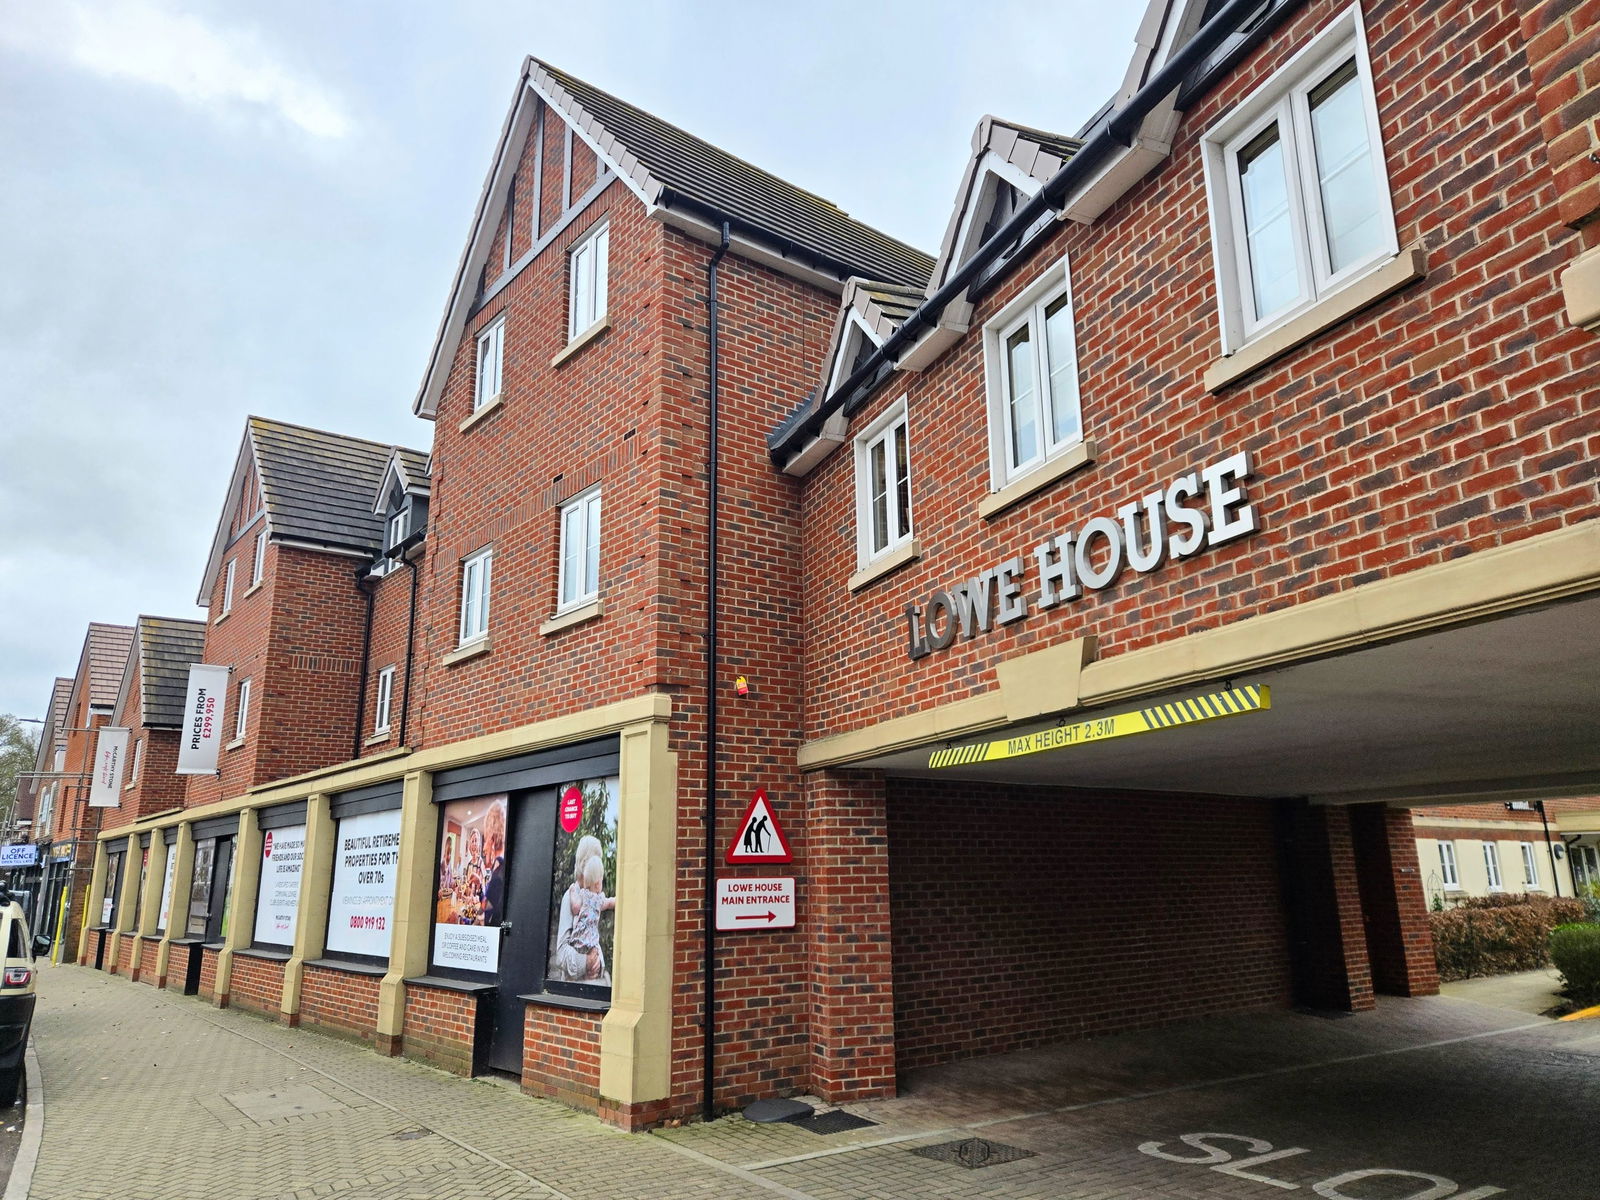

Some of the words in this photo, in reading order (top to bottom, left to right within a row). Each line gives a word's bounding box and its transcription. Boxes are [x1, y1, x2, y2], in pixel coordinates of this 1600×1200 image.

[905, 555, 1028, 661] LOWE
[1033, 450, 1261, 610] HOUSE
[196, 688, 206, 715] FROM
[202, 697, 216, 739] £299,950
[191, 716, 203, 750] PRICES
[1007, 738, 1031, 755] MAX
[1035, 725, 1081, 749] HEIGHT
[1084, 718, 1115, 739] 2.3M
[107, 773, 115, 789] STONE
[344, 836, 371, 851] BEAUTIFUL
[372, 832, 400, 848] RETIREME
[344, 853, 378, 868] PROPERTIES
[378, 852, 390, 866] FOR
[358, 871, 374, 884] OVER
[374, 870, 384, 884] 70s
[728, 884, 753, 892] LOWE
[754, 883, 783, 892] HOUSE
[722, 896, 744, 905] MAIN
[746, 895, 790, 904] ENTRANCE
[350, 916, 364, 928] 0800
[364, 916, 375, 929] 919
[376, 916, 385, 930] 132
[1137, 1132, 1507, 1200] SLO
